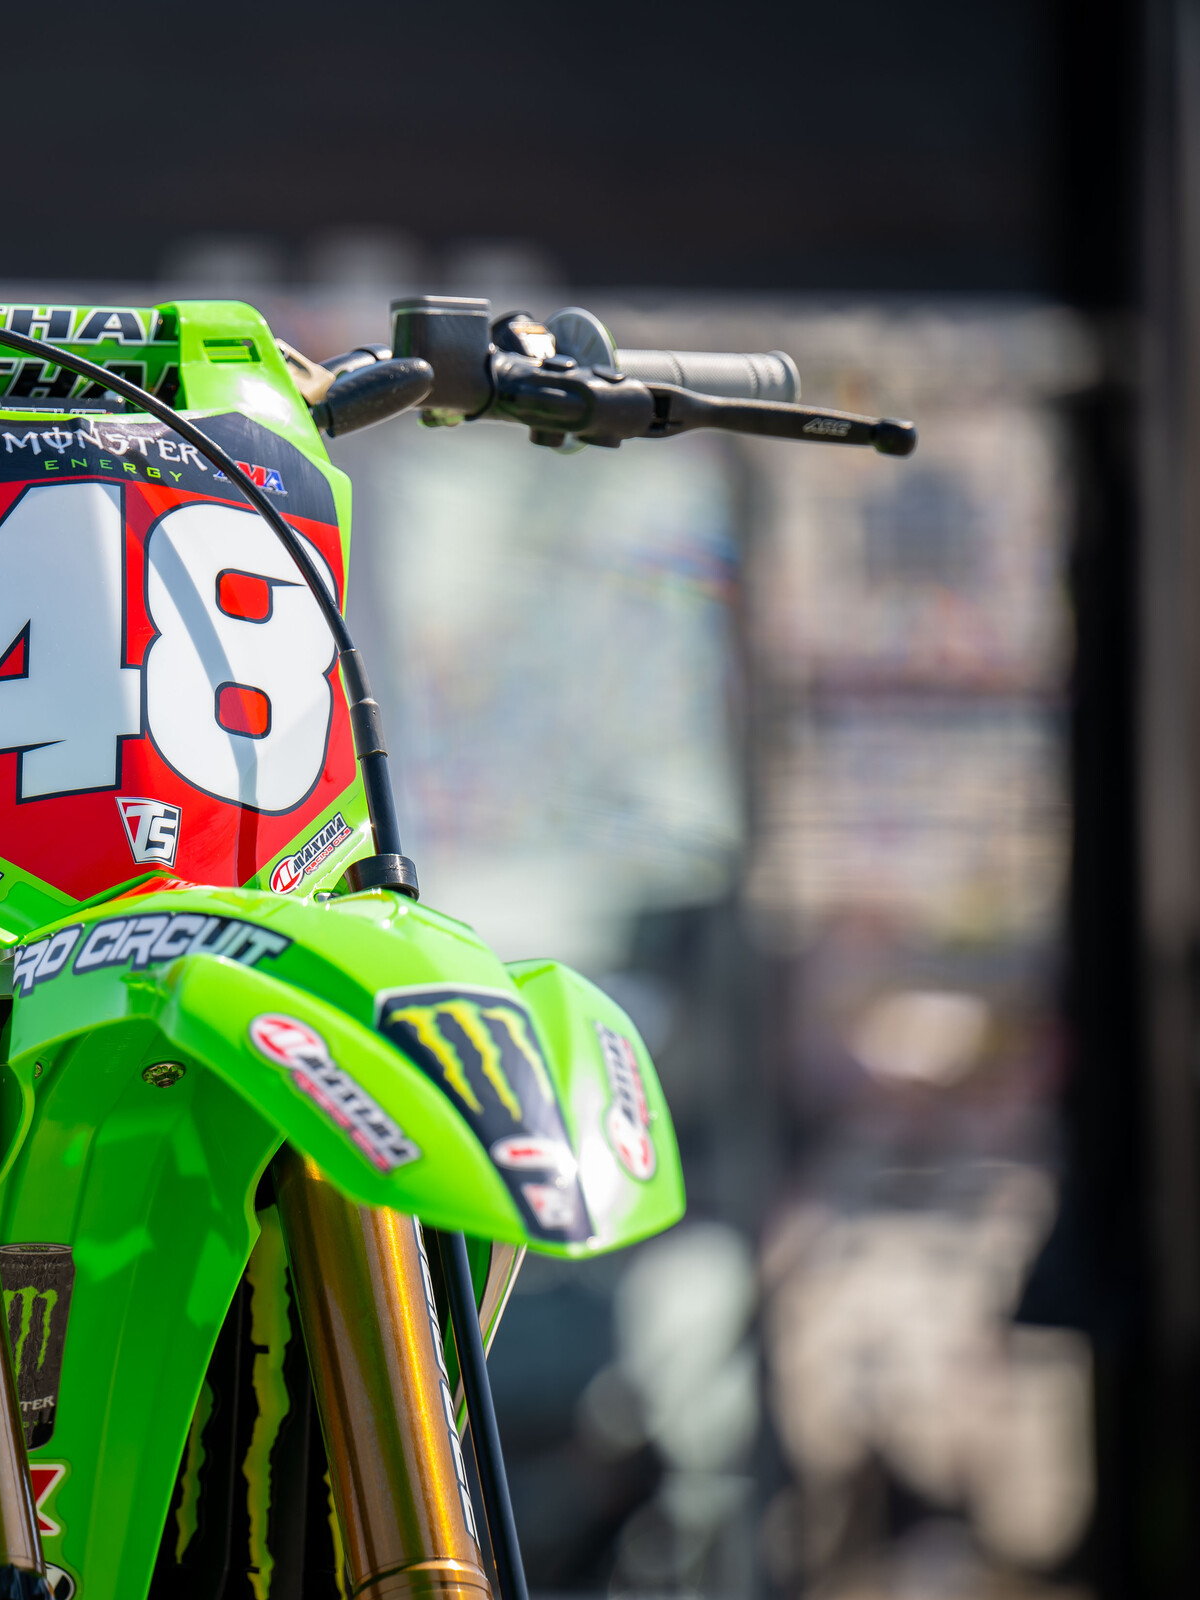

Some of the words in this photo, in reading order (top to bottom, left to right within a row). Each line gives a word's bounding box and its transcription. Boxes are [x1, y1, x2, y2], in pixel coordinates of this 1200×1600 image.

[2, 420, 208, 472] MONSTER
[45, 459, 182, 482] ENERGY
[213, 460, 288, 495] MA
[293, 813, 347, 873] MAXIMA
[305, 845, 334, 874] RACING
[13, 926, 82, 991] RO
[74, 914, 290, 969] CIRCUIT
